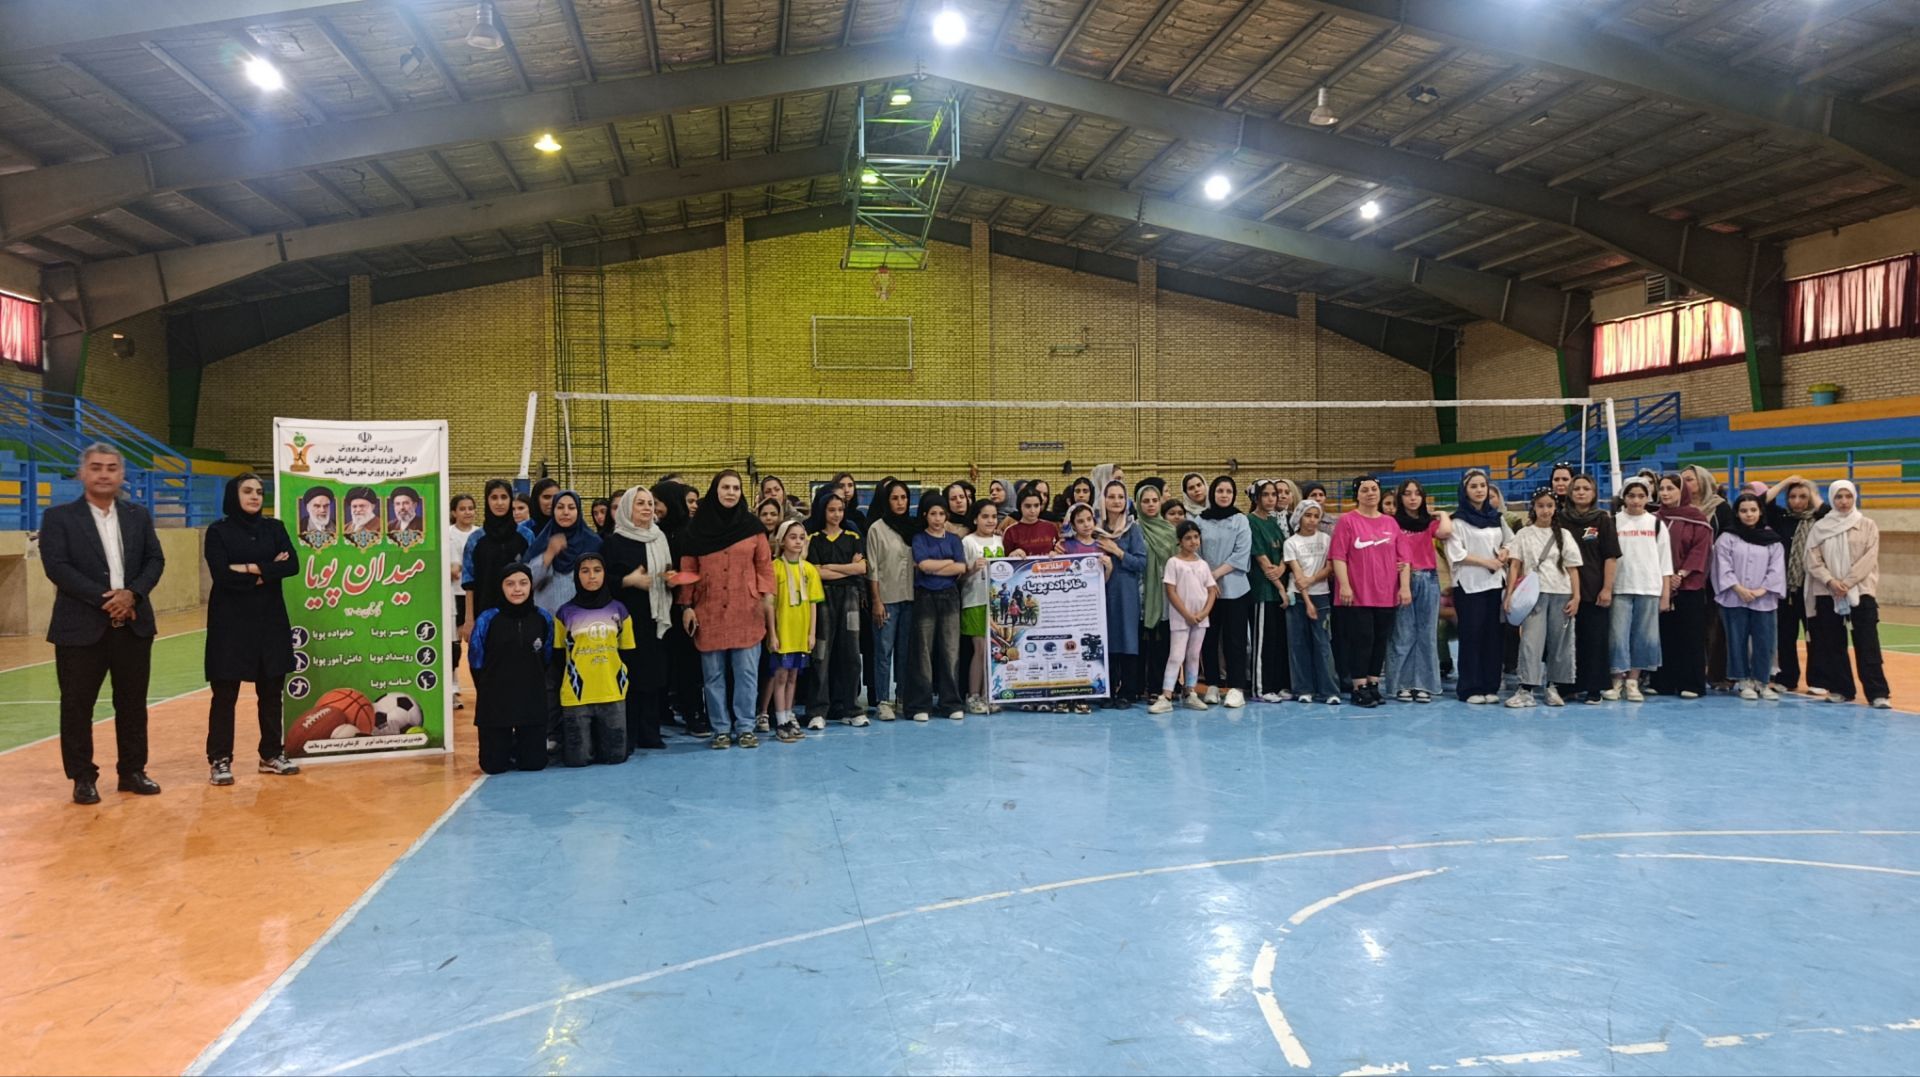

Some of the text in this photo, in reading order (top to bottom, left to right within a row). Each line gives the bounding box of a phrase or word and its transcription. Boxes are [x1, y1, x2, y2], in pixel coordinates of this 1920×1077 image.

[338, 444, 355, 452] پرورش
[361, 443, 378, 452] آموزش
[314, 455, 326, 464] تهران
[370, 456, 384, 465] پرورش
[388, 455, 401, 464] آموزش
[408, 456, 417, 464] اداره
[324, 468, 345, 476] پاکدشت
[345, 467, 367, 476] شهرستان
[367, 468, 384, 477] پرورش
[390, 467, 407, 477] آموزش
[1037, 561, 1064, 571] اطلاعیه
[305, 551, 425, 610] میدان پویا
[312, 627, 354, 640] خانواده پویا
[371, 627, 409, 637] شهر پویا
[312, 654, 362, 667] دانش آموز پویا
[369, 652, 413, 663] رویداد پویا
[371, 678, 412, 689] خانه پویا
